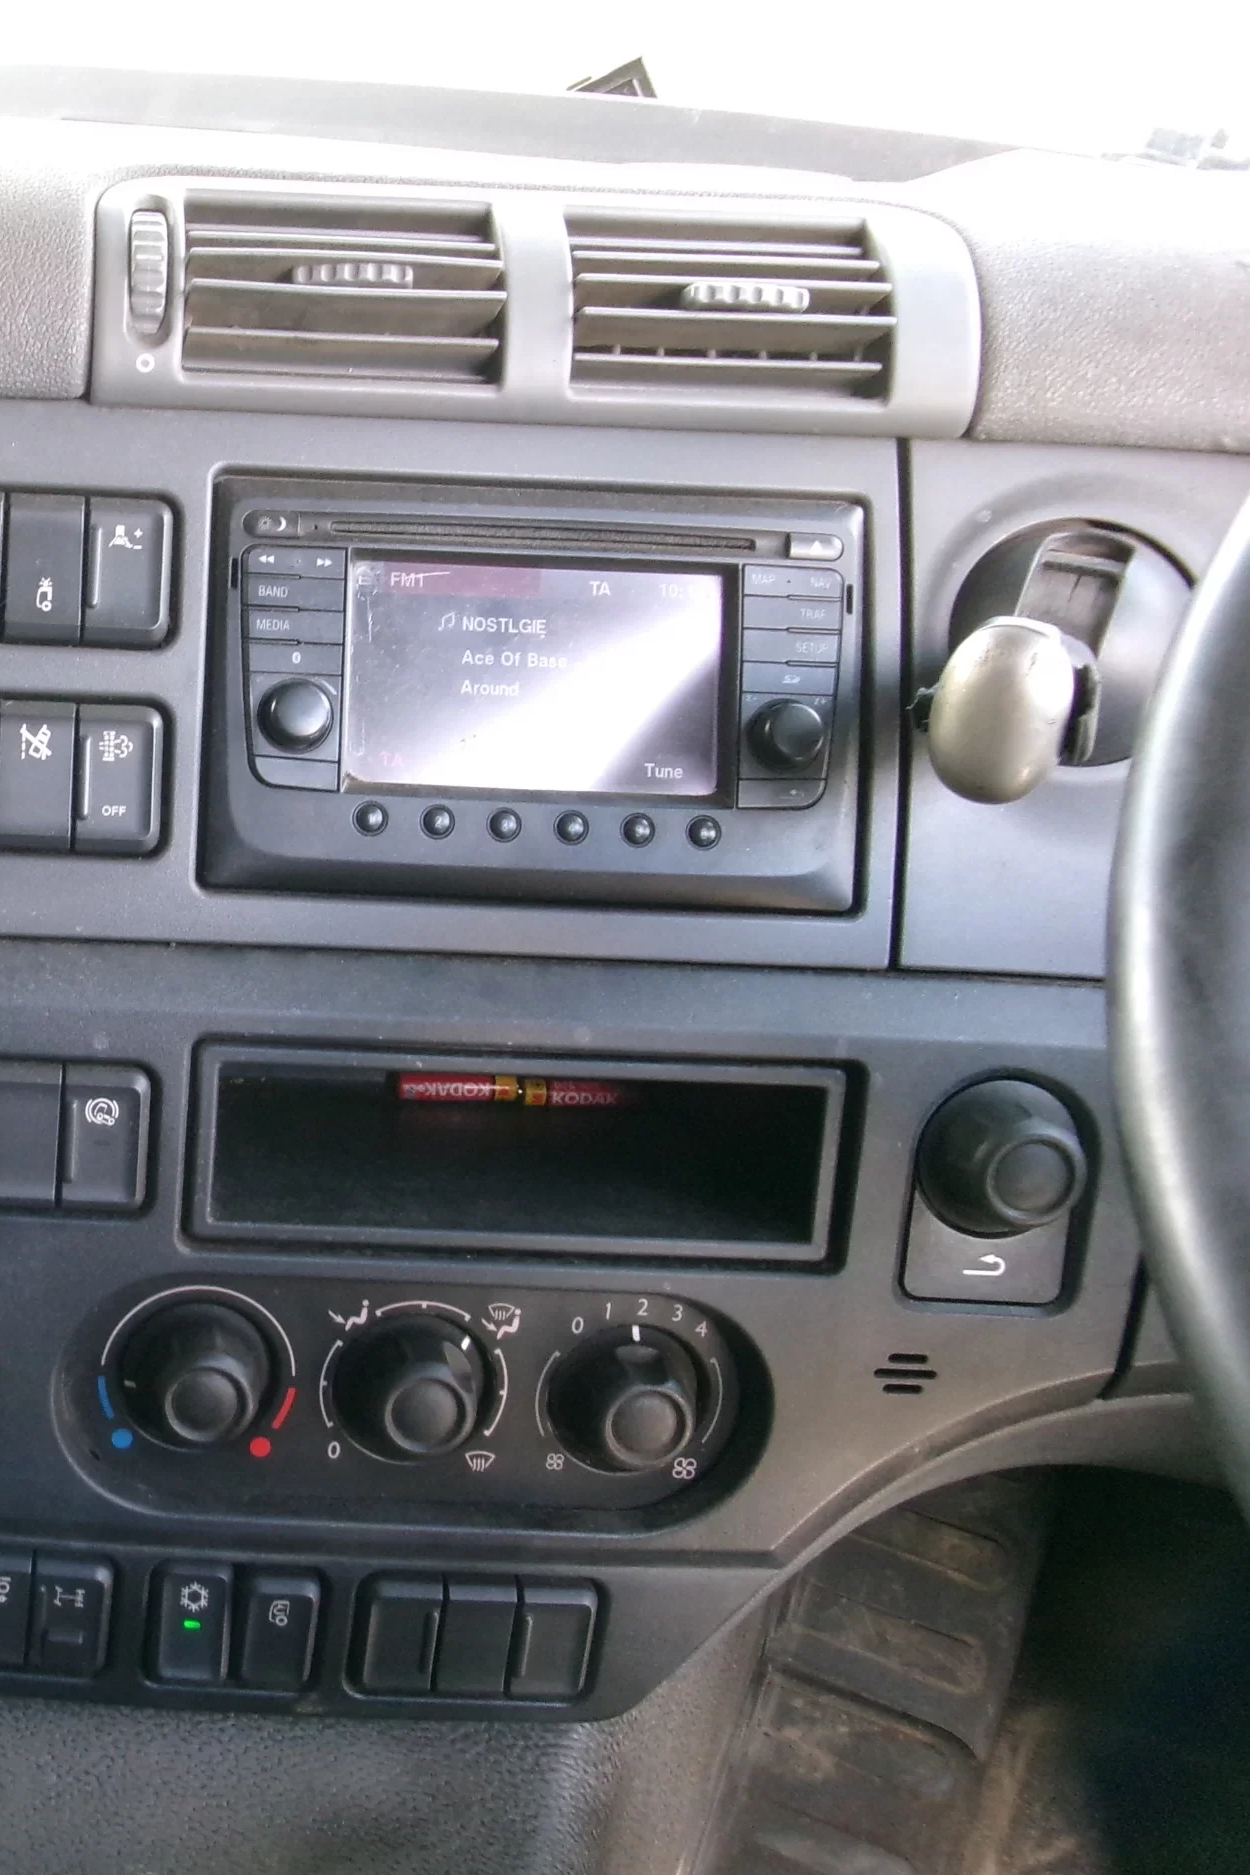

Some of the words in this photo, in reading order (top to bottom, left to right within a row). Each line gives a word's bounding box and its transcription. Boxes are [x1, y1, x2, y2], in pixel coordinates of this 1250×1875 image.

[258, 585, 289, 599] BAND
[589, 580, 611, 597] TA
[256, 618, 291, 632] MEDIA
[461, 616, 546, 635] NOSTLGIE
[461, 650, 495, 666] Ace
[500, 652, 521, 667] Of
[527, 652, 568, 668] Base
[460, 679, 520, 697] Around
[644, 762, 684, 779] Tune
[102, 805, 126, 817] OFF
[425, 1081, 492, 1098] KODAK
[551, 1091, 617, 1105] KODAK
[605, 1302, 612, 1320] 1
[637, 1298, 649, 1315] 2
[671, 1304, 683, 1321] 3
[571, 1316, 584, 1334] 0
[694, 1321, 707, 1337] 4
[327, 1441, 340, 1459] 0
